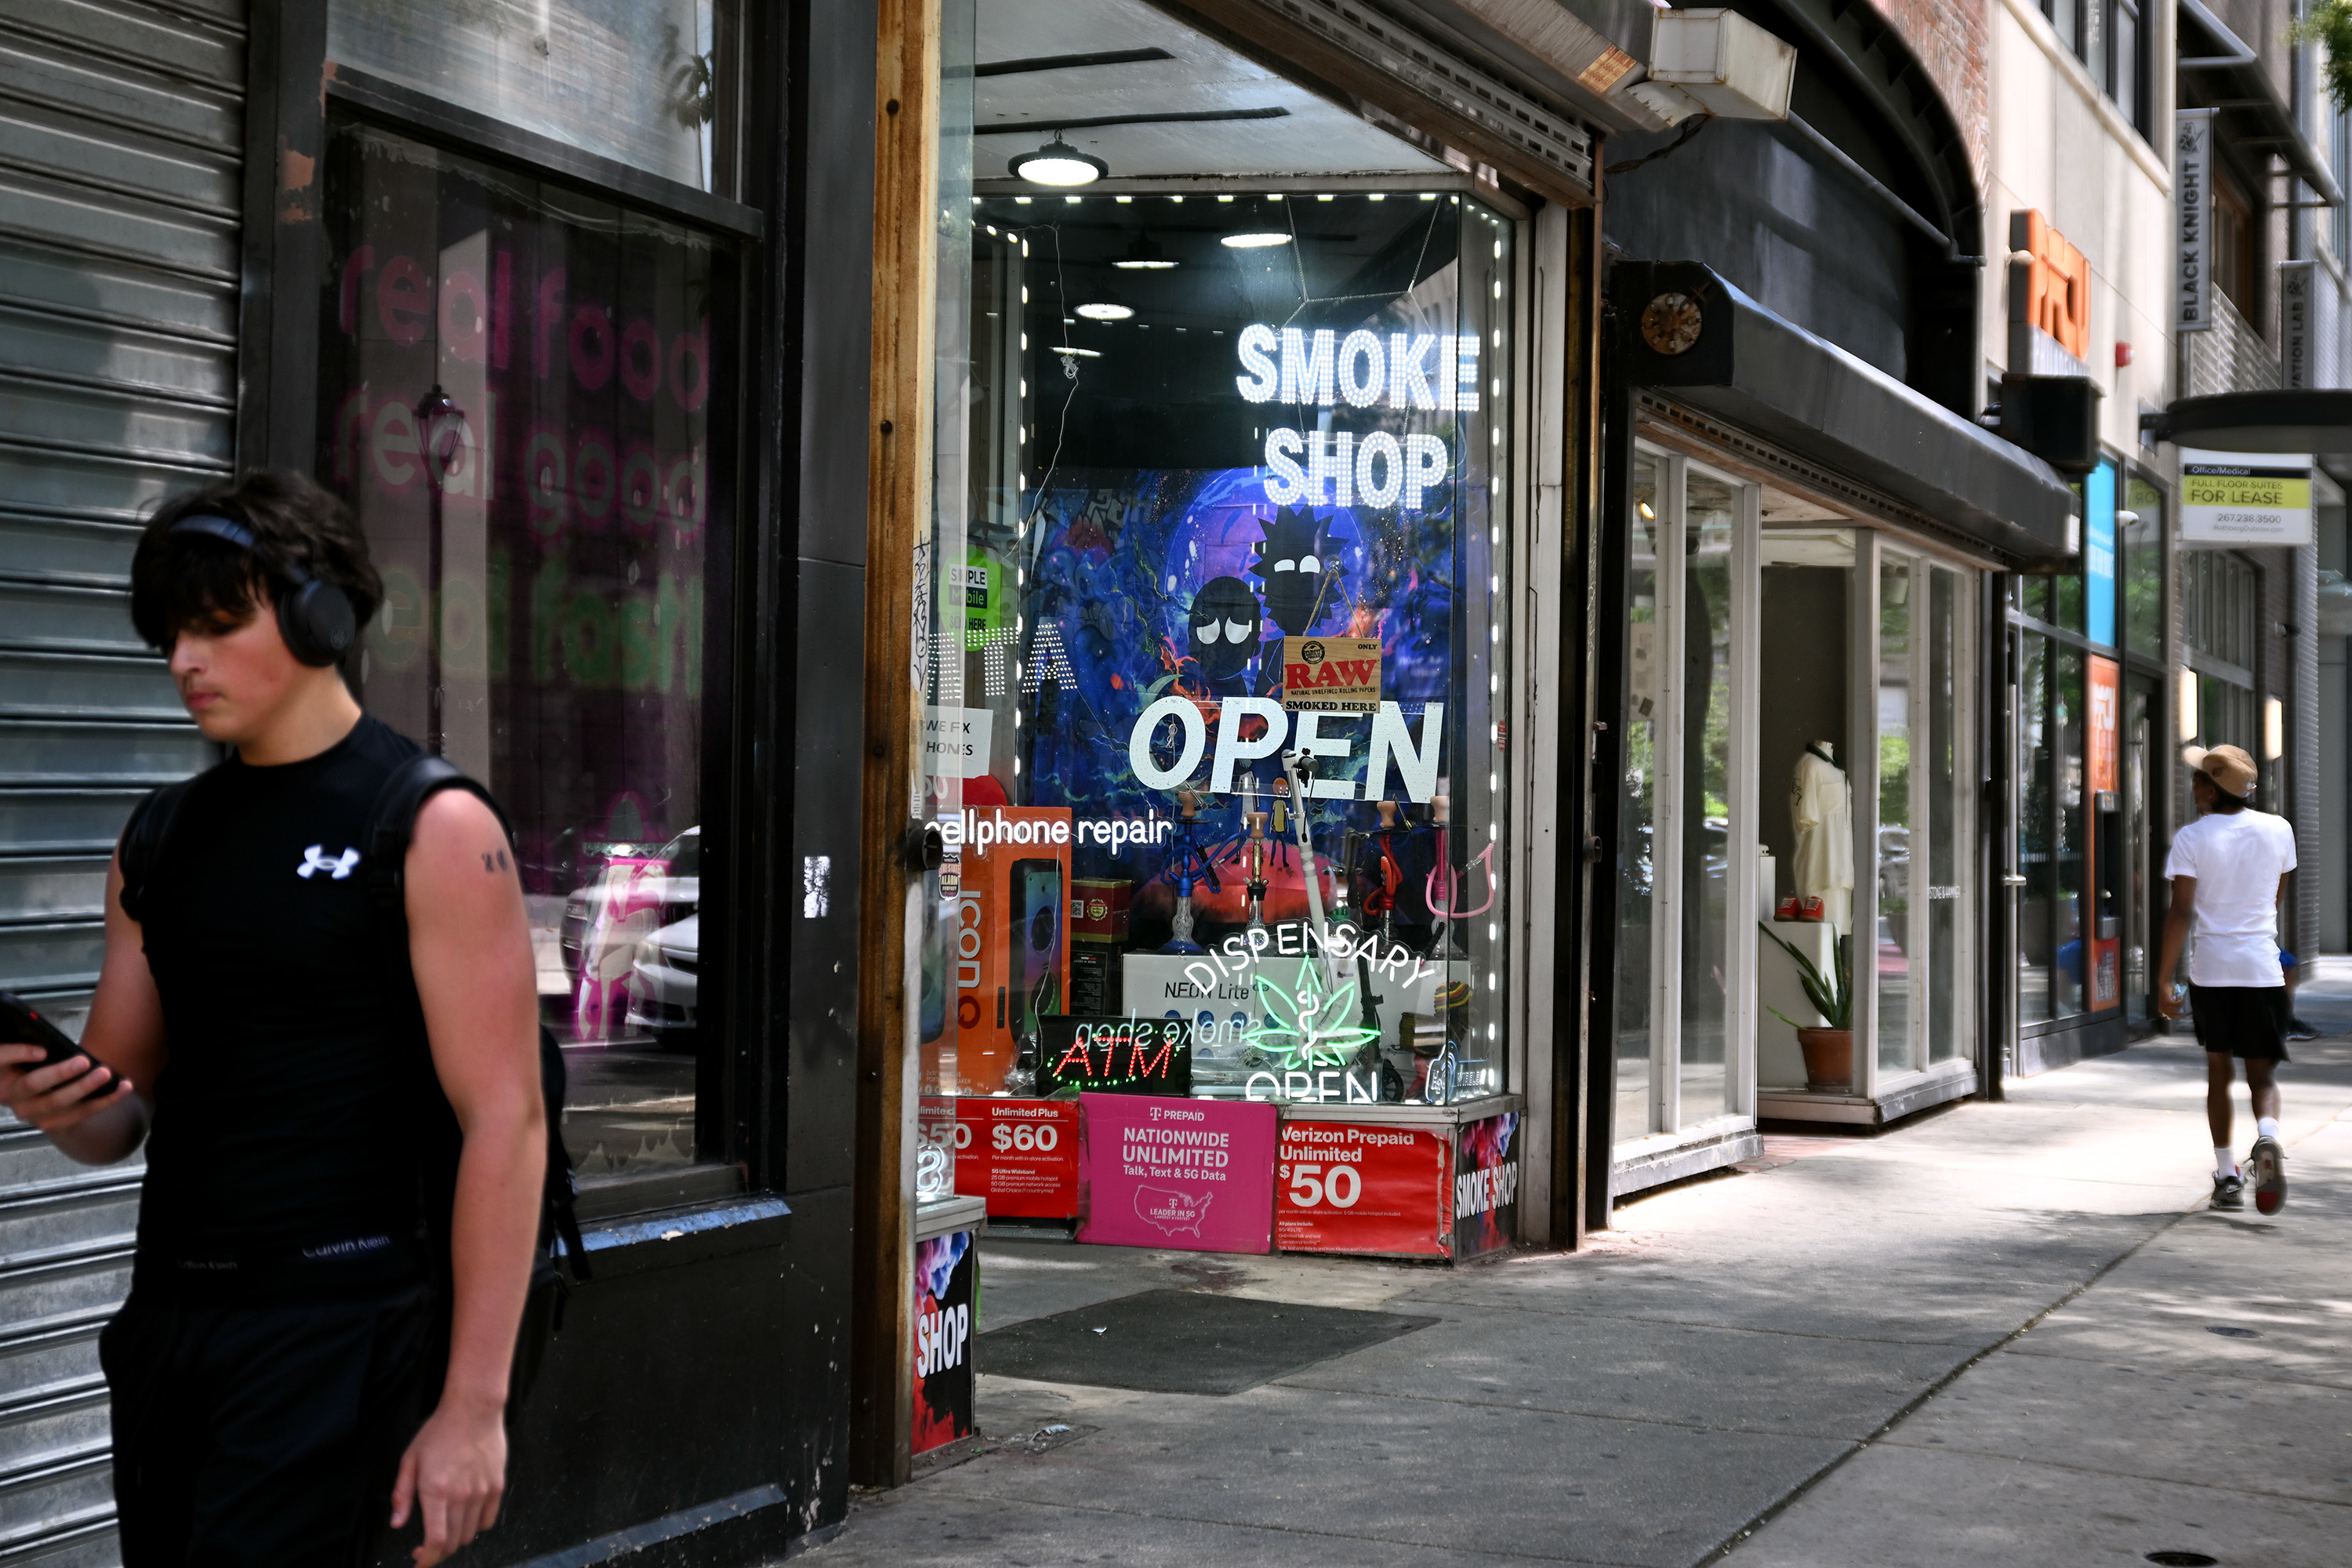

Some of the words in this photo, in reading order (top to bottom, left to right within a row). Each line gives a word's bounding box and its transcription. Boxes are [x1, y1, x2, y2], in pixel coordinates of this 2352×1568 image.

[2183, 160, 2199, 242] KNIGHT
[2183, 250, 2199, 321] BLACK
[2292, 302, 2303, 330] LAB
[340, 245, 511, 370] real
[536, 267, 707, 412] food
[1236, 324, 1480, 412] SMOKE
[334, 384, 496, 500] real
[524, 430, 705, 538] good
[1264, 427, 1448, 509] SHOP
[2192, 466, 2251, 475] Office/Medical
[2192, 479, 2214, 488] FULL
[2217, 480, 2249, 488] FLOOR
[2251, 481, 2283, 490] SUITES
[2191, 489, 2226, 503] FOR
[2232, 491, 2283, 504] LEASE
[2213, 524, 2285, 533] RothbergDubrow.com
[2217, 514, 2281, 524] 267.238.3500
[952, 589, 984, 605] Mbile
[367, 552, 509, 676] eal
[968, 617, 986, 631] HERE
[1284, 659, 1378, 690] RAW
[1286, 701, 1338, 710] SMOKED
[1341, 702, 1377, 712] HERE
[926, 720, 946, 731] WE
[950, 721, 971, 734] FX
[926, 741, 973, 756] HONS
[1129, 695, 1444, 804] OPEN
[1078, 808, 1173, 855] repair
[941, 874, 958, 885] ALARM
[1184, 921, 1435, 996] DISPENSARY
[1164, 982, 1212, 1000] NEON
[1218, 983, 1249, 1000] Lite
[1053, 1036, 1173, 1078] ATM
[1245, 1070, 1377, 1104] OPEN
[918, 1106, 955, 1115] limited
[992, 1107, 1036, 1116] Unlimited
[1037, 1109, 1058, 1117] Plus
[1163, 1110, 1205, 1121] PREPAID
[992, 1123, 1058, 1153] $60
[1123, 1127, 1229, 1148] NATIONWIDE
[1282, 1127, 1345, 1143] Verizon
[1347, 1129, 1414, 1147] Prepaid
[1123, 1145, 1229, 1167] UNLIMITED
[1279, 1145, 1362, 1162] Unlimited
[1123, 1165, 1147, 1178] Talk,
[1149, 1167, 1171, 1178] Text
[1174, 1168, 1181, 1178] &
[1184, 1169, 1198, 1179] 5G
[1201, 1170, 1226, 1181] Data
[1457, 1168, 1490, 1220] SMOKE
[1492, 1162, 1518, 1210] SHOP
[1150, 1208, 1176, 1217] LEADER
[917, 1303, 968, 1379] SHOP
